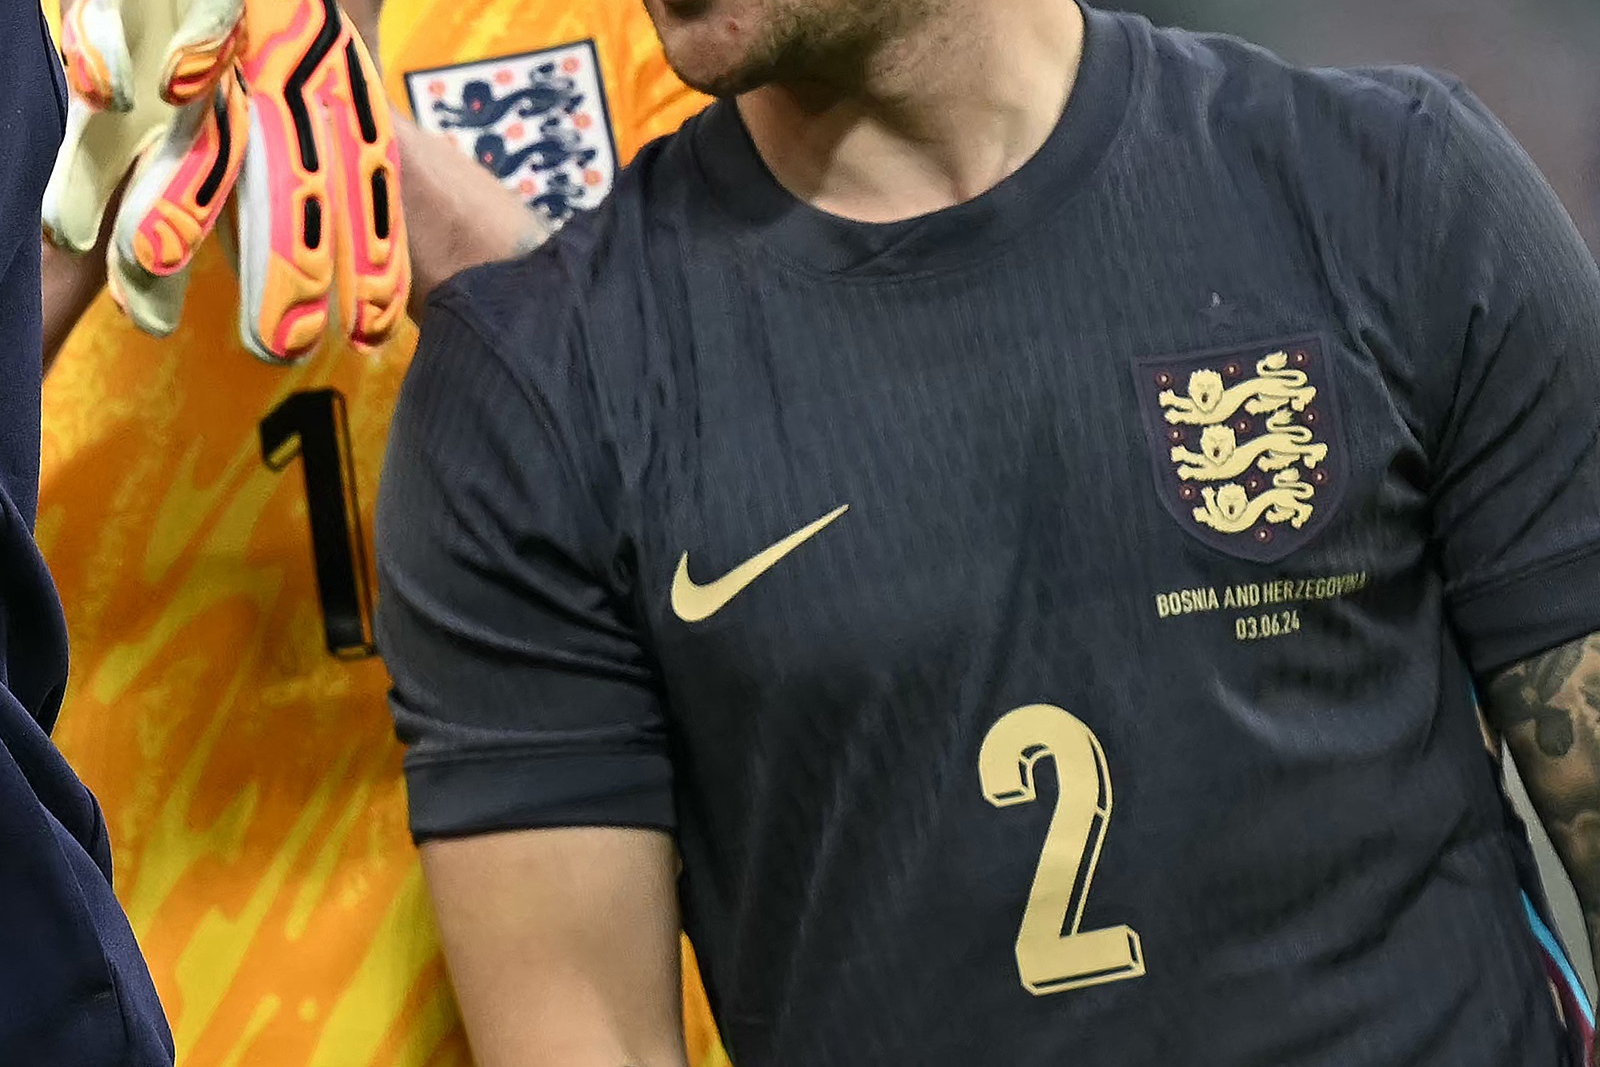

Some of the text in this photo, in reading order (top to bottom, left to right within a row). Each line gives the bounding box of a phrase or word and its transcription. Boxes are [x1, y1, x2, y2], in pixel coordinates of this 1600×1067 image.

[259, 387, 376, 661] 1
[1155, 586, 1220, 619] BOSNIA
[1224, 583, 1261, 609] AND
[1235, 609, 1300, 640] 03.06.24
[978, 703, 1146, 996] 2
